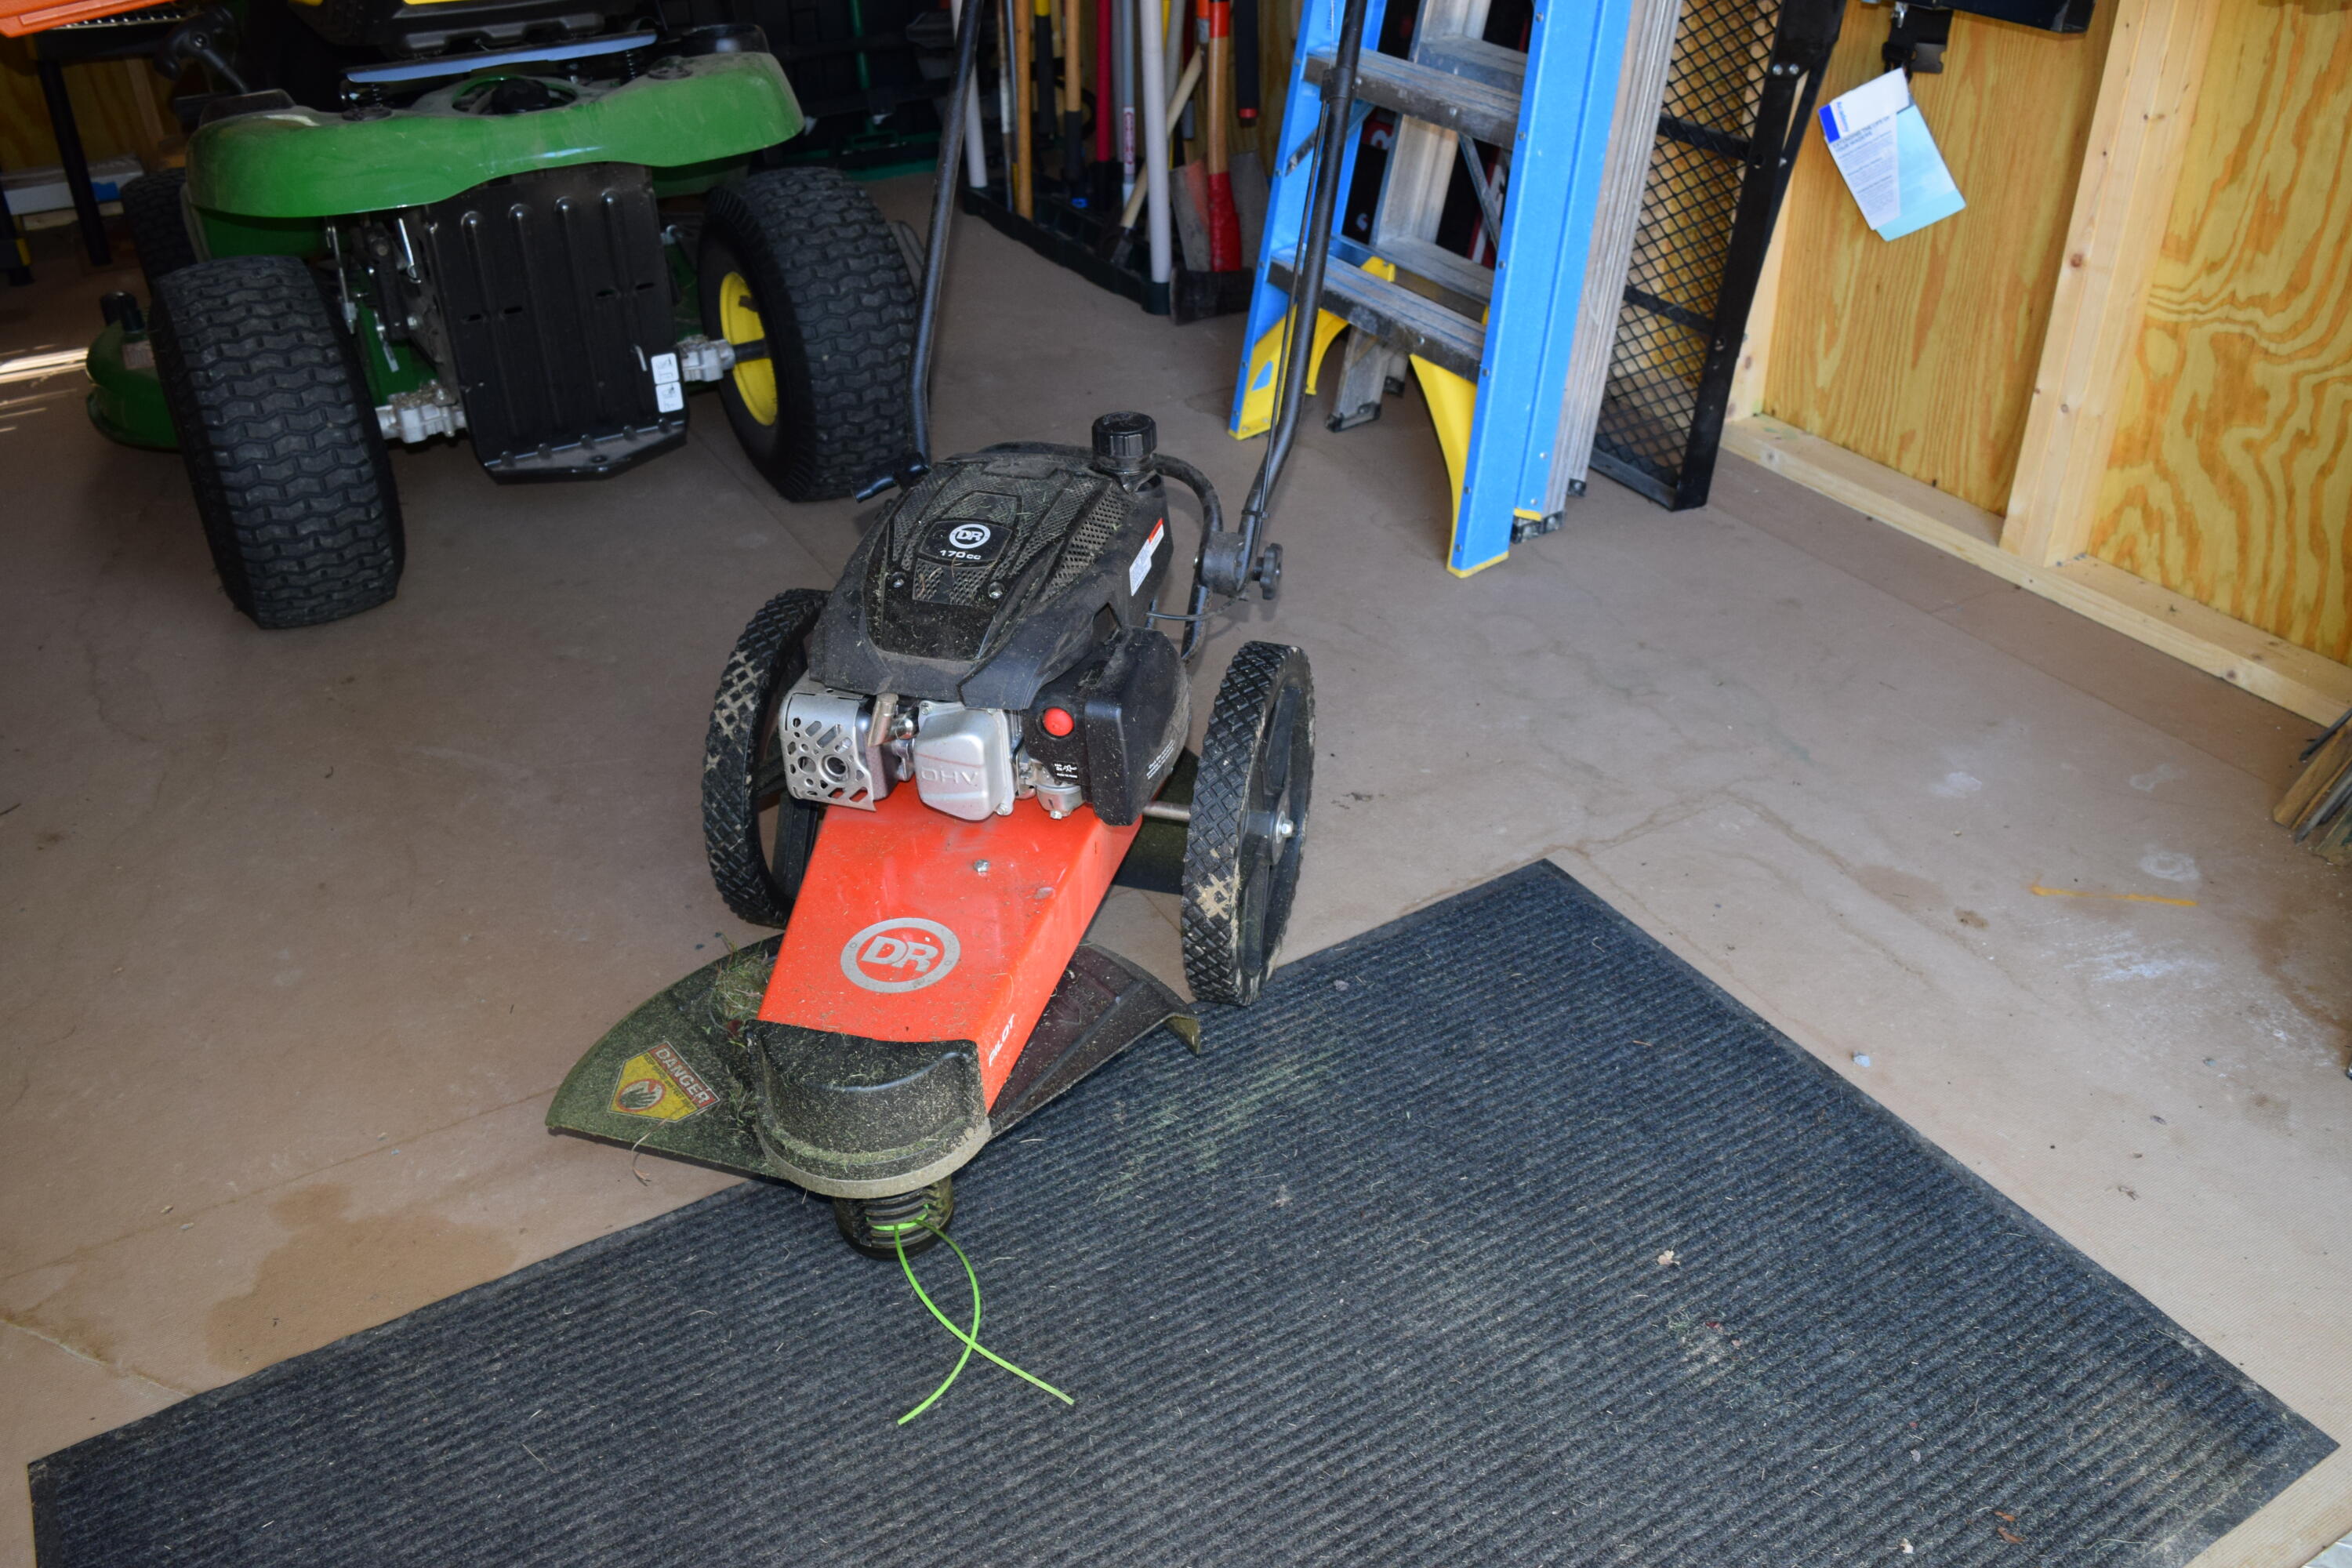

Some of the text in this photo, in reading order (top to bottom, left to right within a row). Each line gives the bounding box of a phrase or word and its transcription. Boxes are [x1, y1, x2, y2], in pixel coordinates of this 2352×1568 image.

[956, 530, 984, 541] DR
[921, 768, 978, 785] OHV
[862, 935, 939, 973] DR
[989, 1013, 1016, 1067] PILOT
[655, 1047, 710, 1104] DANGER
